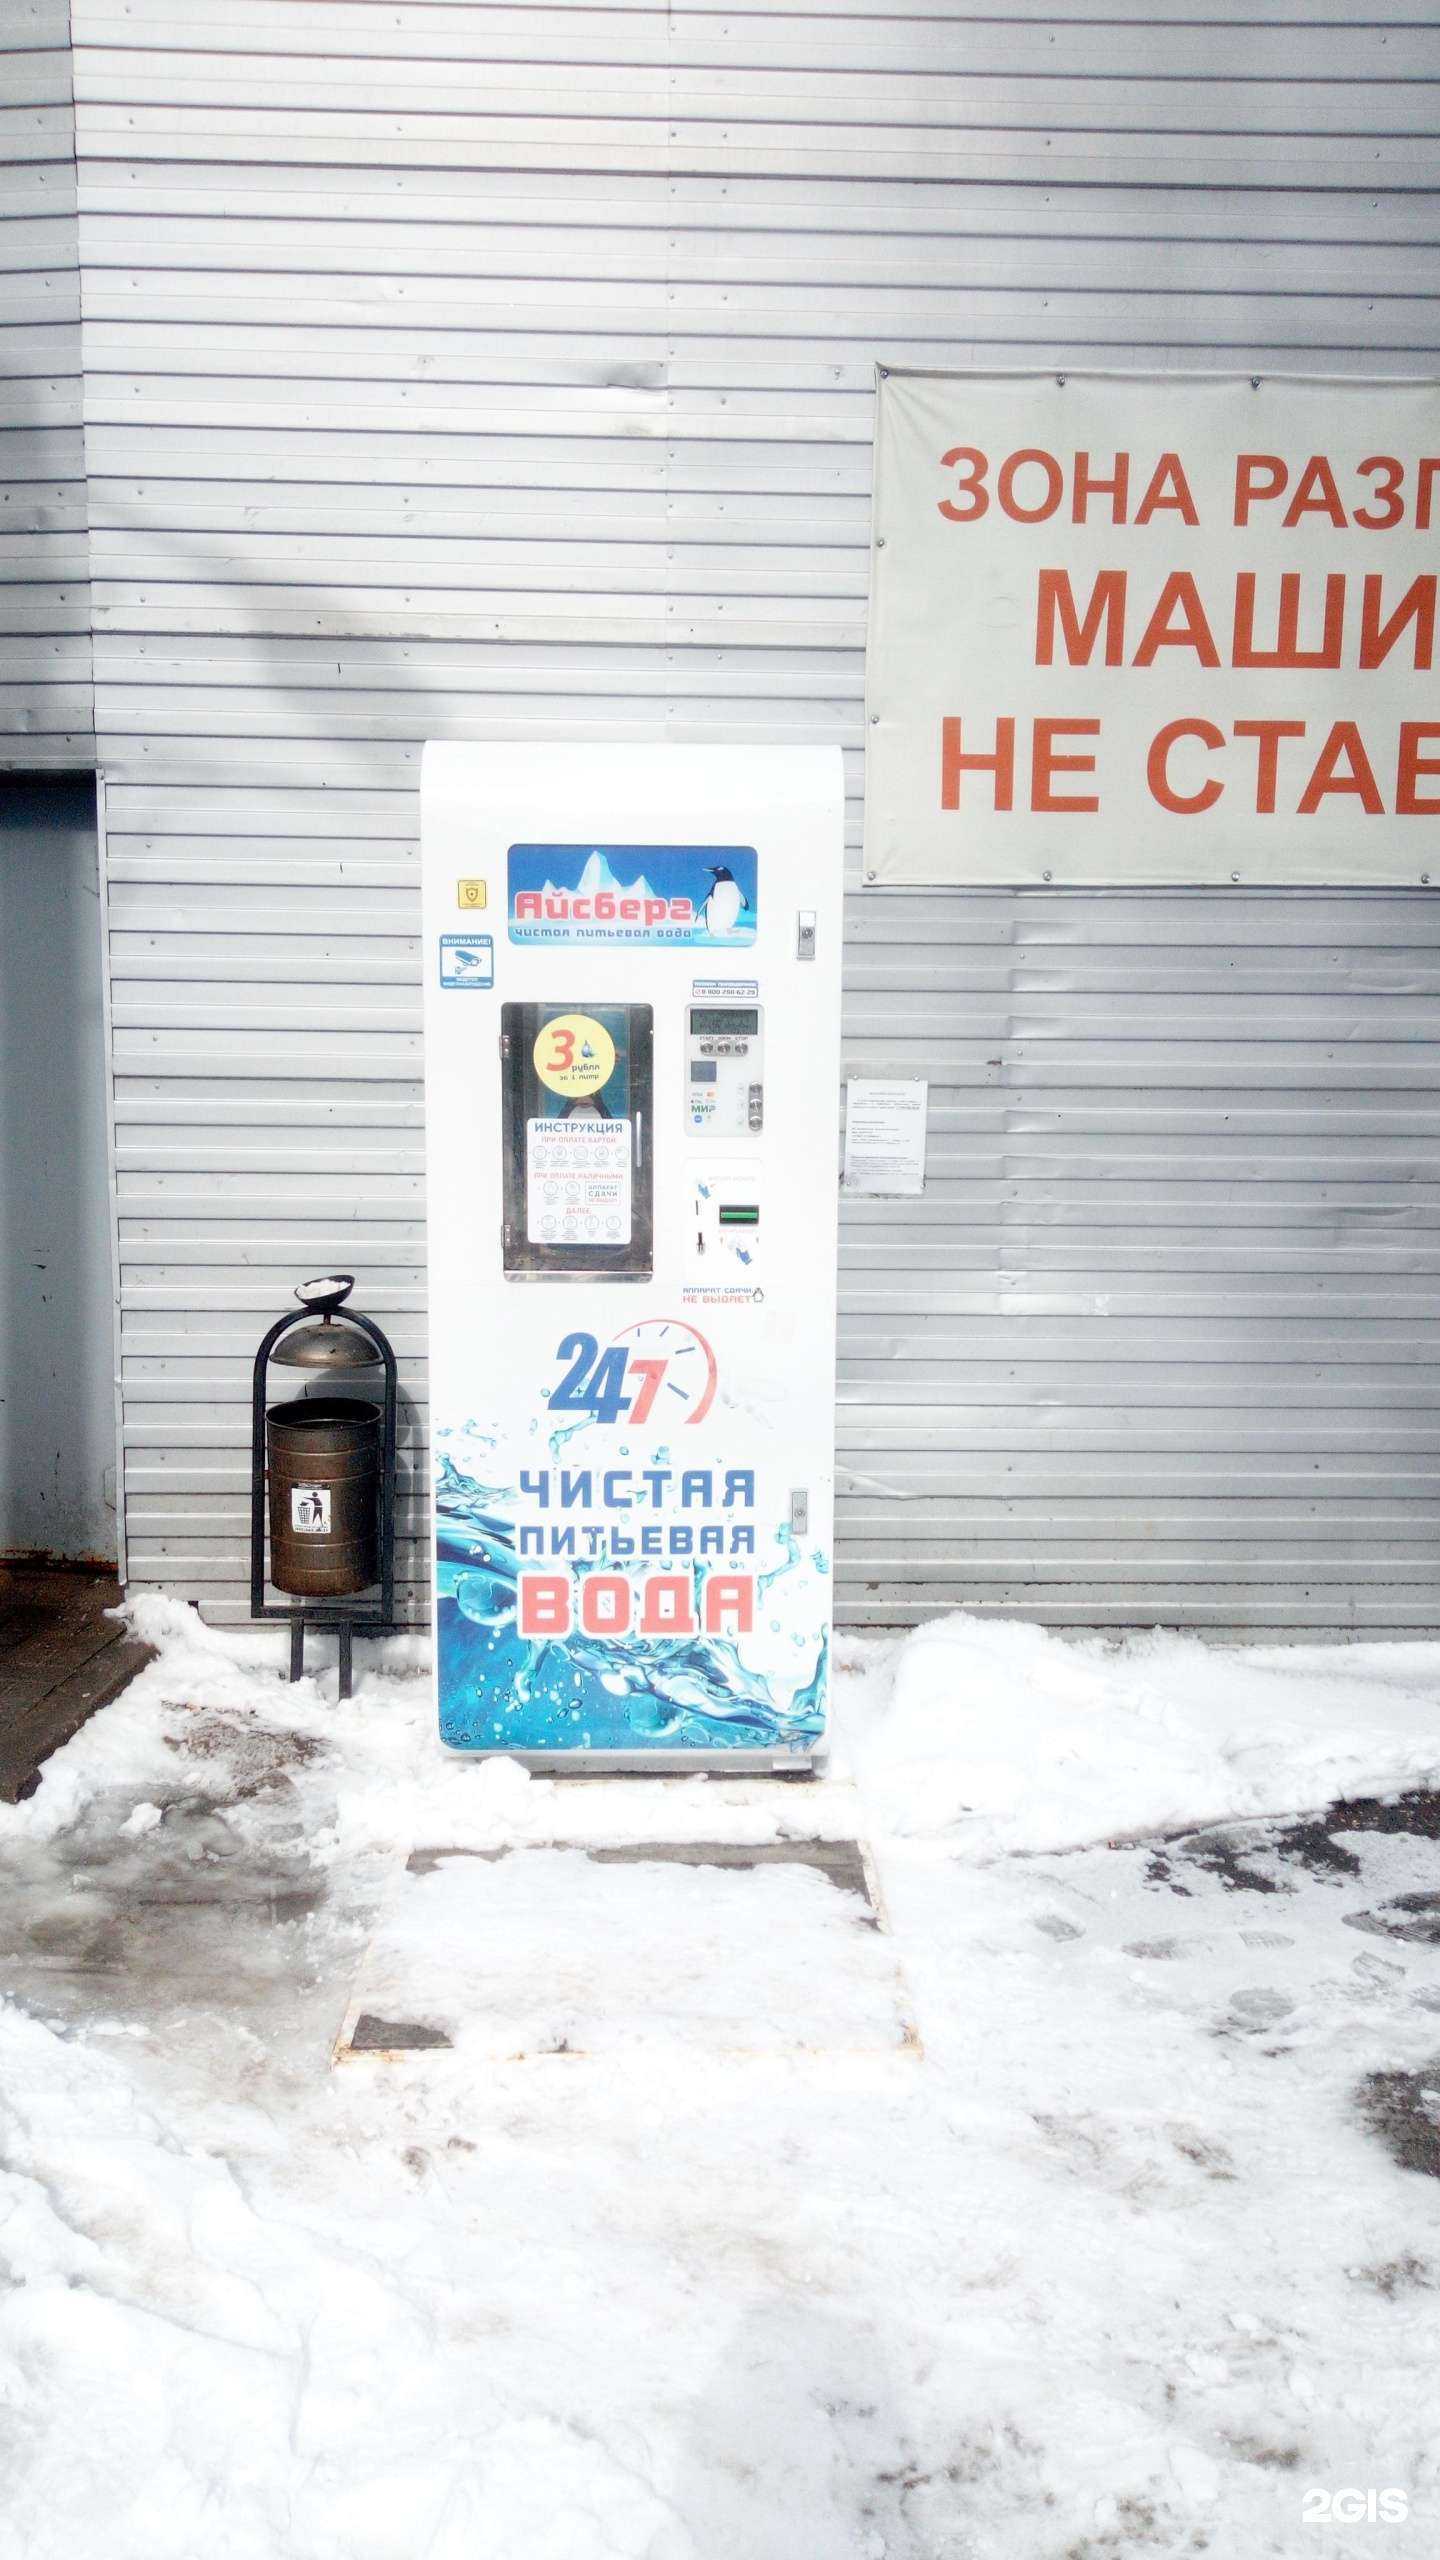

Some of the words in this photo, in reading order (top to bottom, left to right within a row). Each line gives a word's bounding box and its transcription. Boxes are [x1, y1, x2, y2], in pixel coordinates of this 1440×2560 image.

[937, 447, 1200, 526] ЗОНА
[1035, 569, 1437, 670] МАШИ
[940, 716, 1100, 813] НЕ
[516, 892, 692, 926] Айсберг
[546, 1029, 575, 1072] 3
[535, 1123, 622, 1134] ИНСТРУКЦИЯ
[519, 1470, 755, 1508] ЧИСТАЯ
[520, 1525, 755, 1555] ПИТЬЕВАЯ
[521, 1575, 754, 1634] ВОДА
